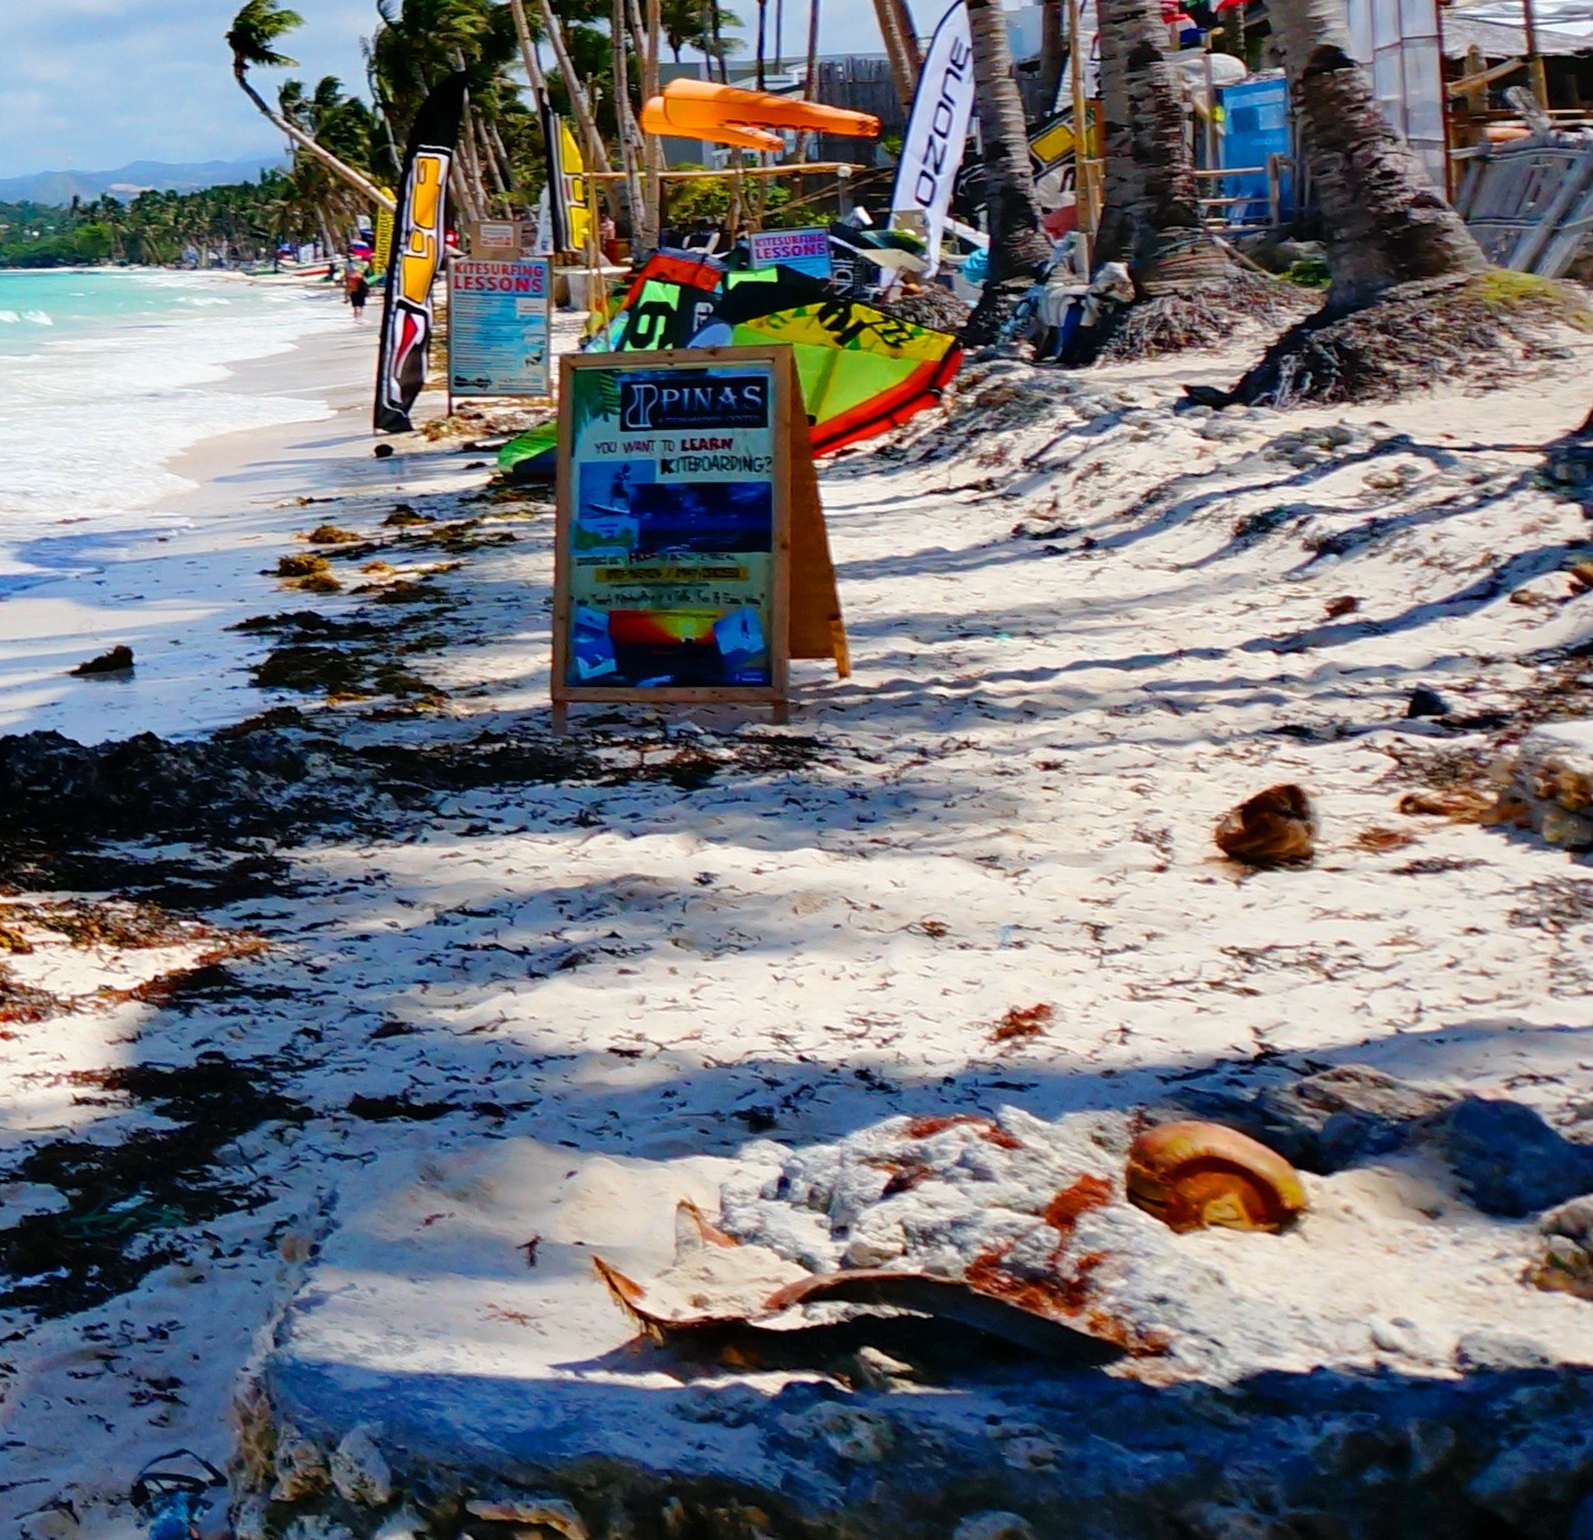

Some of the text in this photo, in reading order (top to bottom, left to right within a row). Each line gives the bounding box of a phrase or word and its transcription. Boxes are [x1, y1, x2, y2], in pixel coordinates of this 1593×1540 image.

[914, 36, 972, 208] OZONE
[754, 233, 826, 247] KITESURFING
[755, 243, 826, 259] LESSONS
[453, 263, 544, 276] KITESURFING
[453, 276, 544, 293] LESSONS
[661, 385, 763, 410] PINAS
[594, 437, 734, 455] YOU WANT TO LEARN
